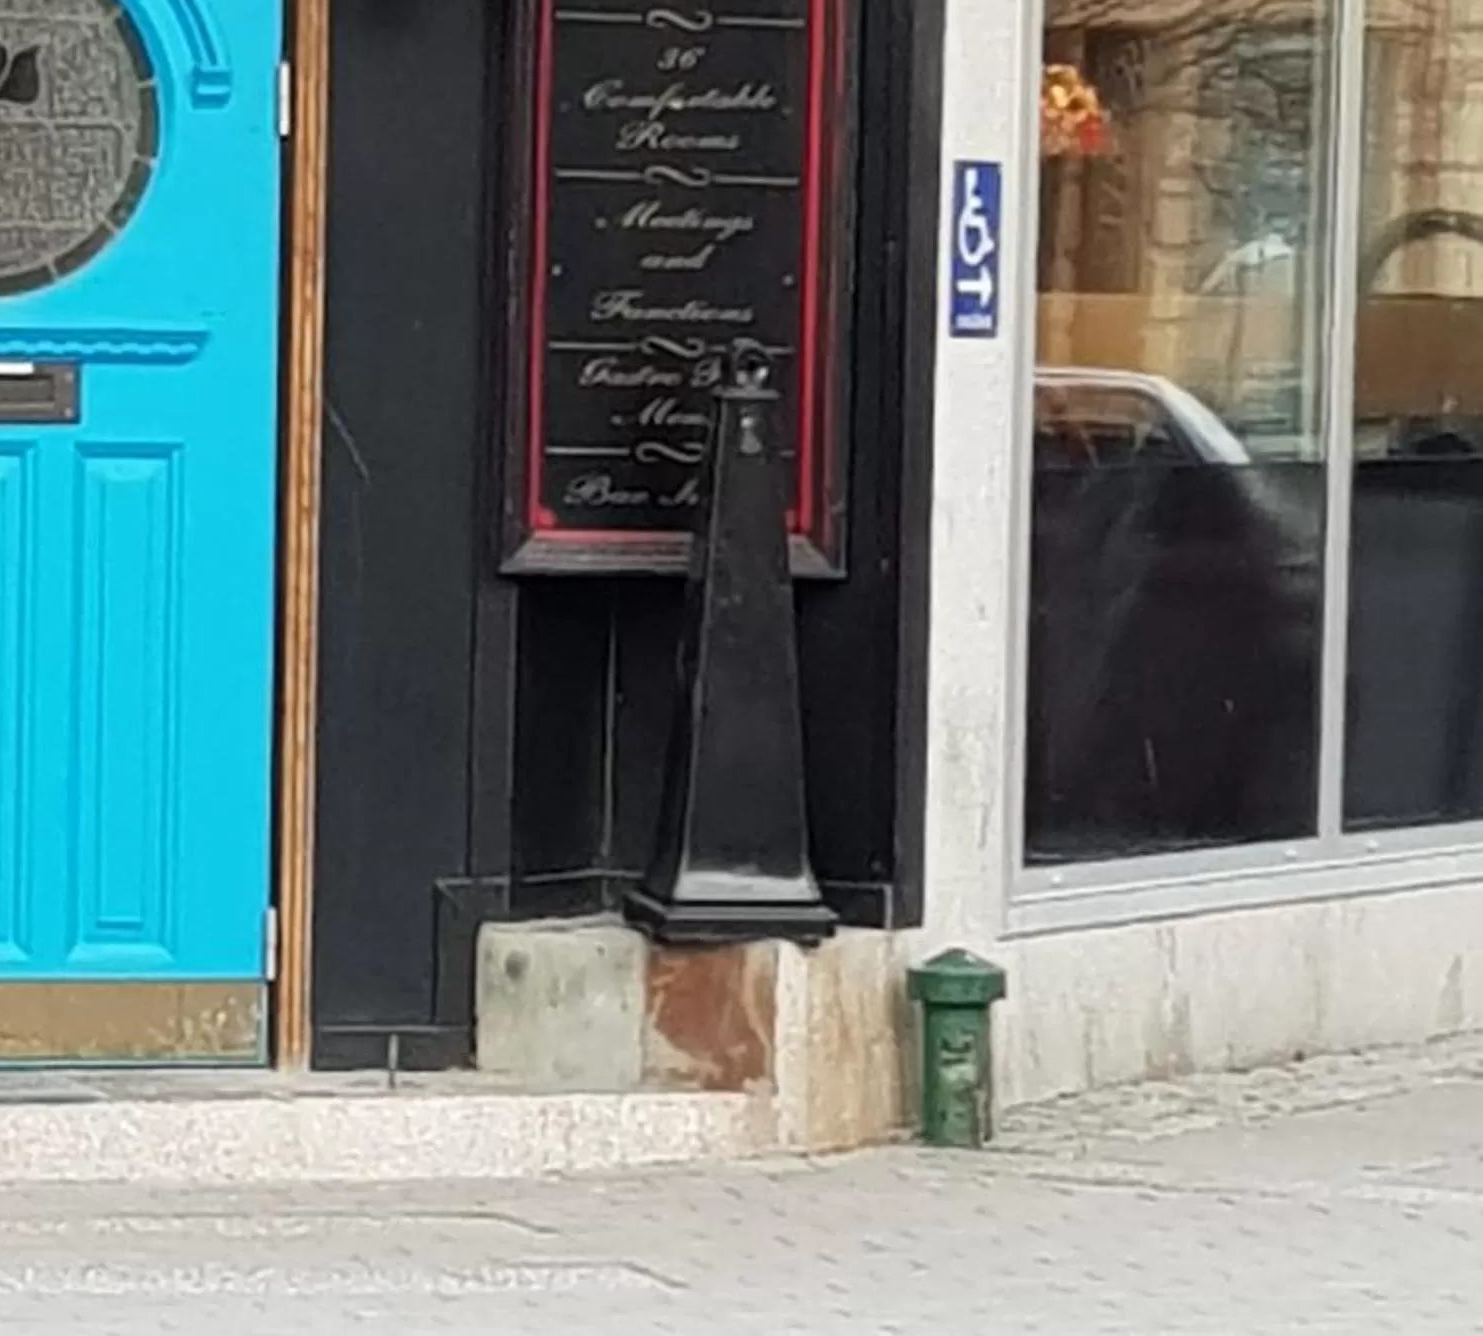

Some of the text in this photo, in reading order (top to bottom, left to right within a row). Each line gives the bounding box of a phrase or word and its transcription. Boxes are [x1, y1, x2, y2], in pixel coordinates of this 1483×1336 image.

[582, 78, 777, 120] Comfortable
[616, 120, 740, 150] Rooms
[639, 244, 715, 269] and
[590, 289, 754, 323] Functions
